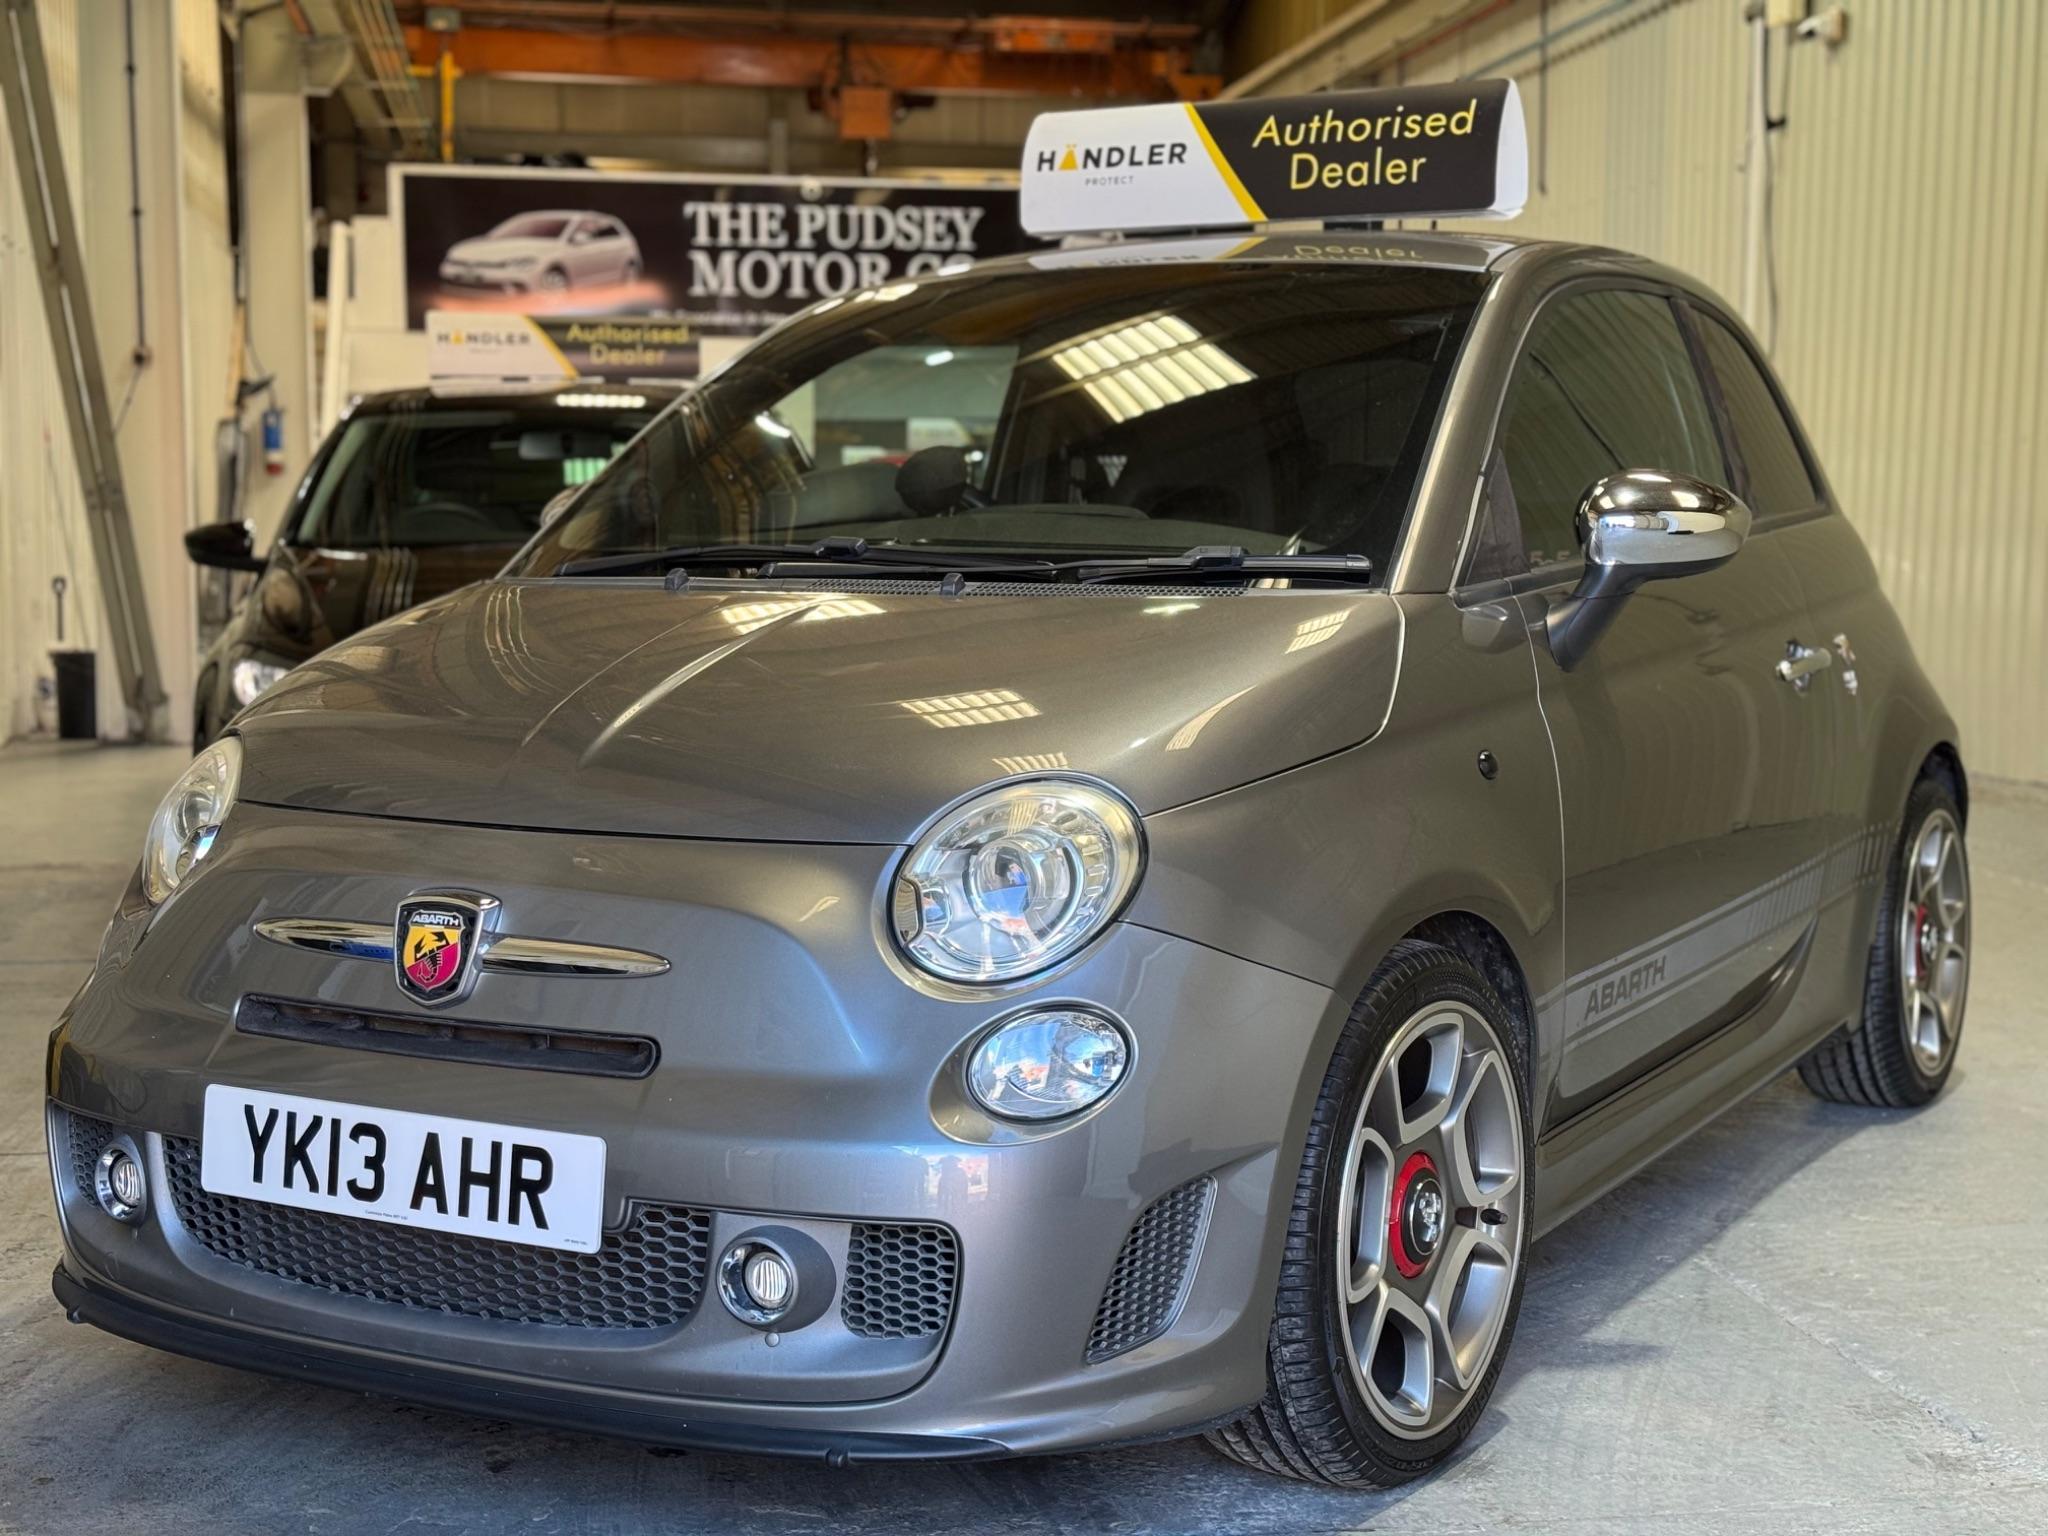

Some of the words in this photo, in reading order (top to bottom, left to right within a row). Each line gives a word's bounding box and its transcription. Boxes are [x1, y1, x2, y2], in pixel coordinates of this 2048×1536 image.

[1252, 99, 1478, 149] Authorised
[1036, 142, 1188, 173] HÄNDLER
[1290, 147, 1427, 190] Dealer
[1085, 176, 1134, 186] PROTECT
[683, 201, 788, 249] THE
[793, 203, 985, 252] PUDSEY
[688, 250, 892, 298] MOTOR
[566, 323, 690, 343] Authorised
[590, 344, 666, 366] Dealer
[412, 914, 459, 926] ABARTH
[1584, 955, 1667, 1021] ABARTH
[244, 1104, 388, 1204] YK13
[409, 1132, 555, 1231] AHR
